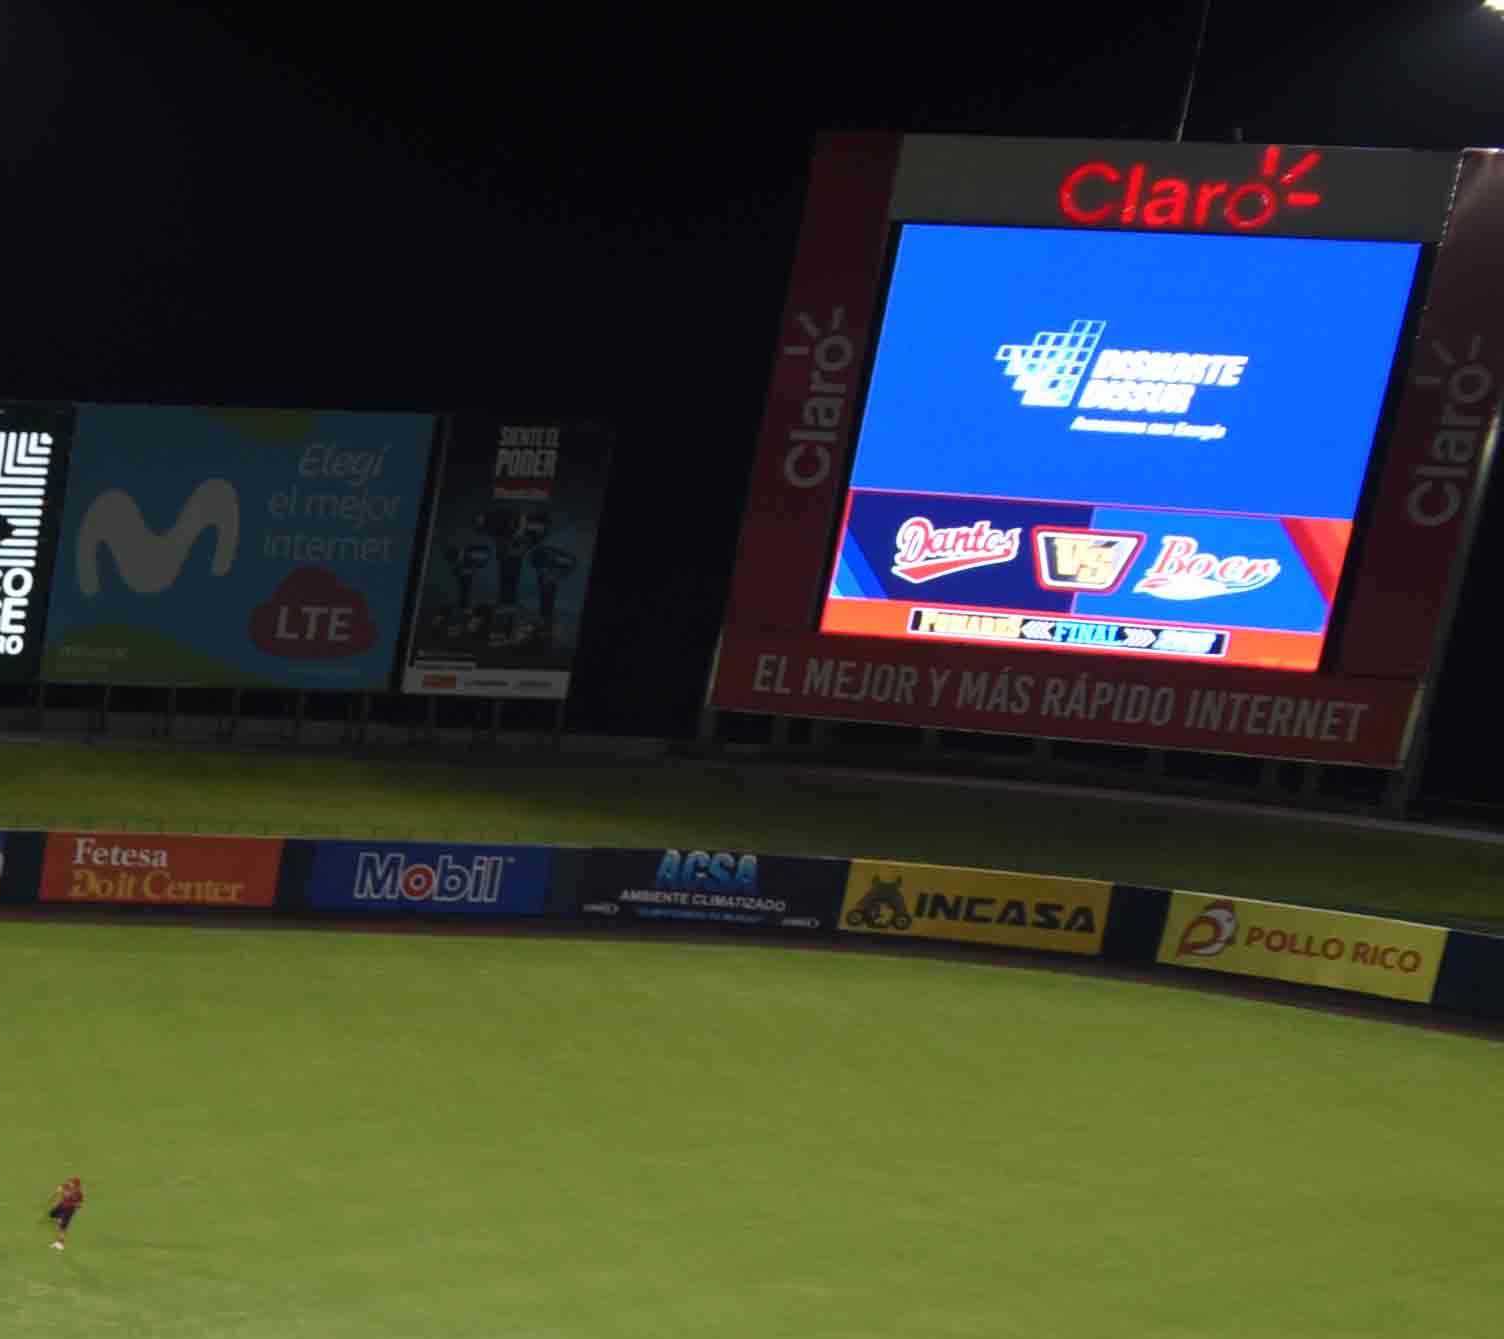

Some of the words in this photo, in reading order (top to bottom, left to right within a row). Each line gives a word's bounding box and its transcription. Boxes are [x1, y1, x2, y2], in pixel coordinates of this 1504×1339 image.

[1059, 162, 1276, 230] Claro
[783, 333, 854, 489] Claro
[1407, 362, 1492, 528] Claro
[268, 483, 298, 519] el
[302, 493, 401, 529] mejor
[895, 518, 1021, 565] Dantos
[1148, 535, 1280, 582] Boer
[273, 605, 355, 642] LTE
[1052, 620, 1124, 648] FINAL
[751, 655, 792, 696] EL
[801, 657, 919, 707] MEJOR
[928, 666, 952, 709] Y
[955, 665, 1036, 717] MÁS
[1039, 674, 1177, 728] RÁPIDO
[1183, 688, 1370, 744] INTERNET
[73, 838, 169, 868] Fetesa
[657, 848, 761, 890] ACSA
[143, 869, 244, 904] Center
[353, 851, 503, 903] Mobil
[621, 888, 690, 906] AMBIENTE
[691, 893, 787, 913] CLIMATIZADO
[914, 893, 1096, 934] INCASA
[1246, 926, 1346, 961] POLLO
[1351, 941, 1423, 974] RICO
